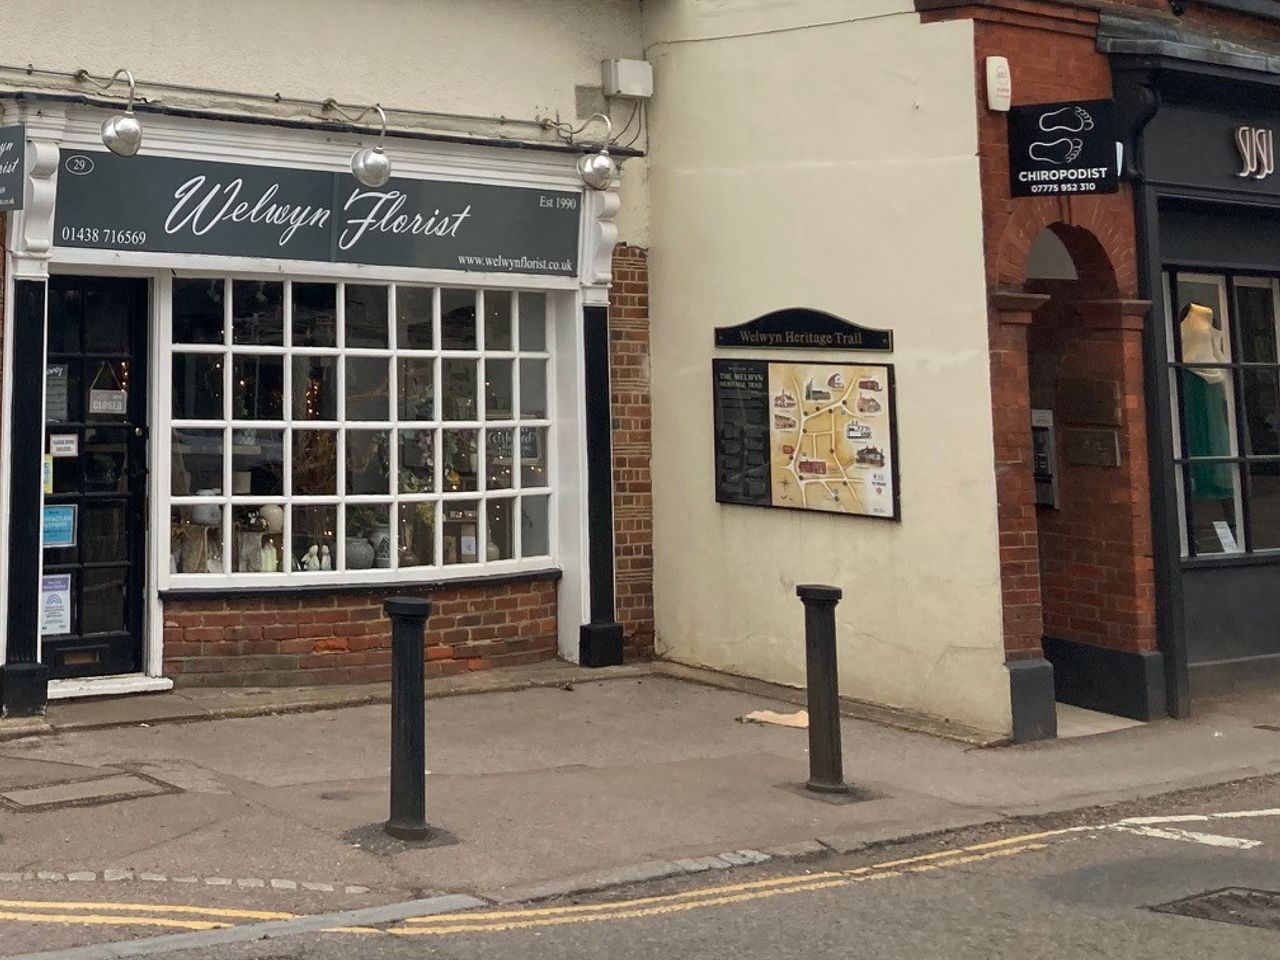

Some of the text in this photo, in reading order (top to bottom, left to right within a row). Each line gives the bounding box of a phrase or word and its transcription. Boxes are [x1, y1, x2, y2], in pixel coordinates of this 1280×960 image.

[73, 159, 86, 170] 29
[1019, 167, 1108, 182] CHIROPODIST
[1031, 182, 1096, 193] 07775 952 310
[539, 196, 577, 210] Est 1990
[164, 175, 472, 249] Welwyn Florist
[62, 226, 146, 244] 01438 716569
[458, 255, 573, 271] www.welwynflorist.co.uk
[740, 331, 862, 345] Welwyn Heritage Trail
